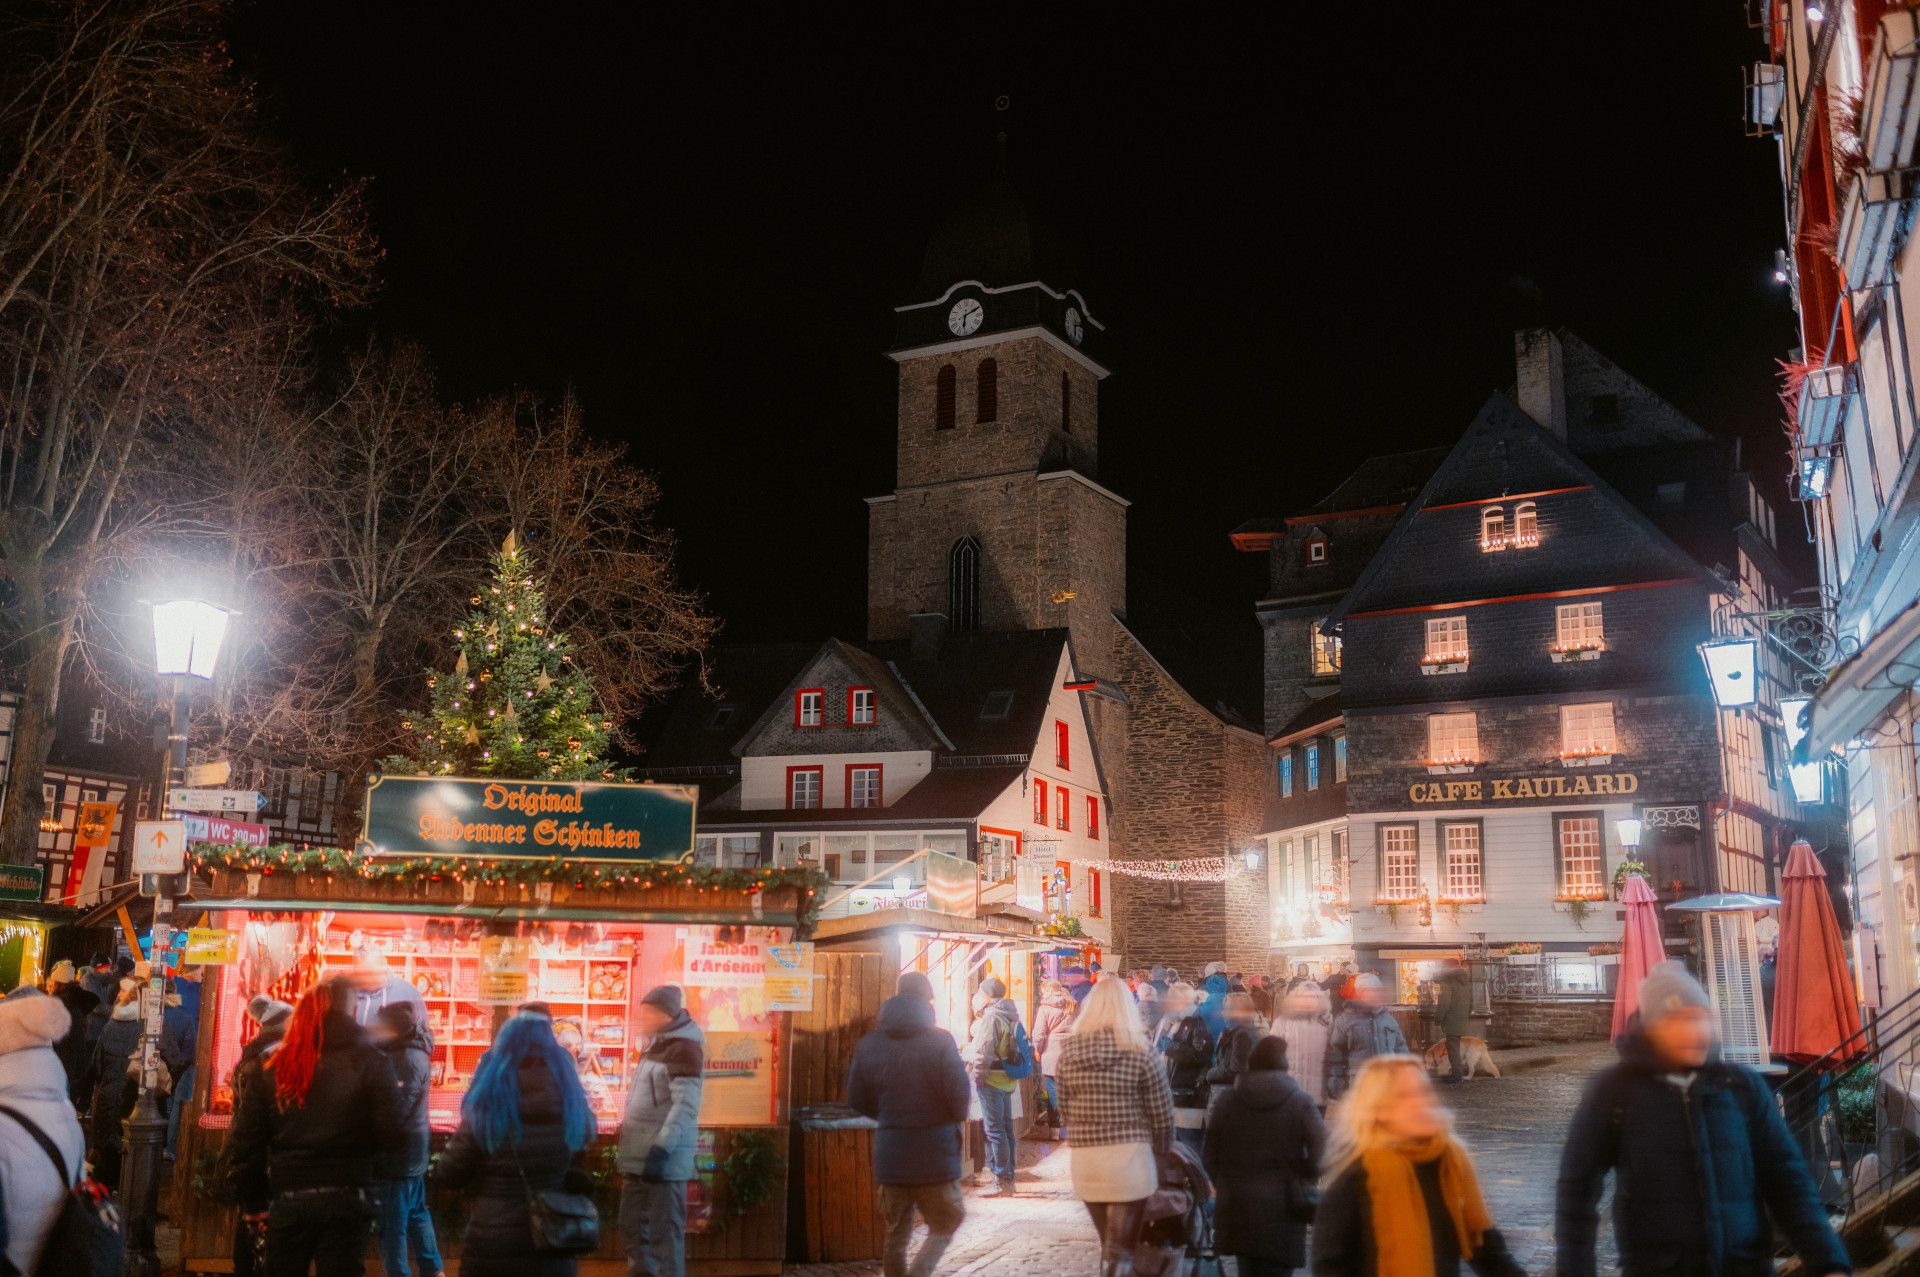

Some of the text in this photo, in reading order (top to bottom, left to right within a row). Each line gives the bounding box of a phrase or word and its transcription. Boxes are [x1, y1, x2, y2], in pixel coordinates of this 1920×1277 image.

[483, 783, 584, 816] Original
[1409, 773, 1639, 803] CAFE KAULARD
[210, 822, 259, 845] WC 300 m
[418, 814, 641, 851] Ardenner Schinken
[701, 942, 759, 957] Jambon
